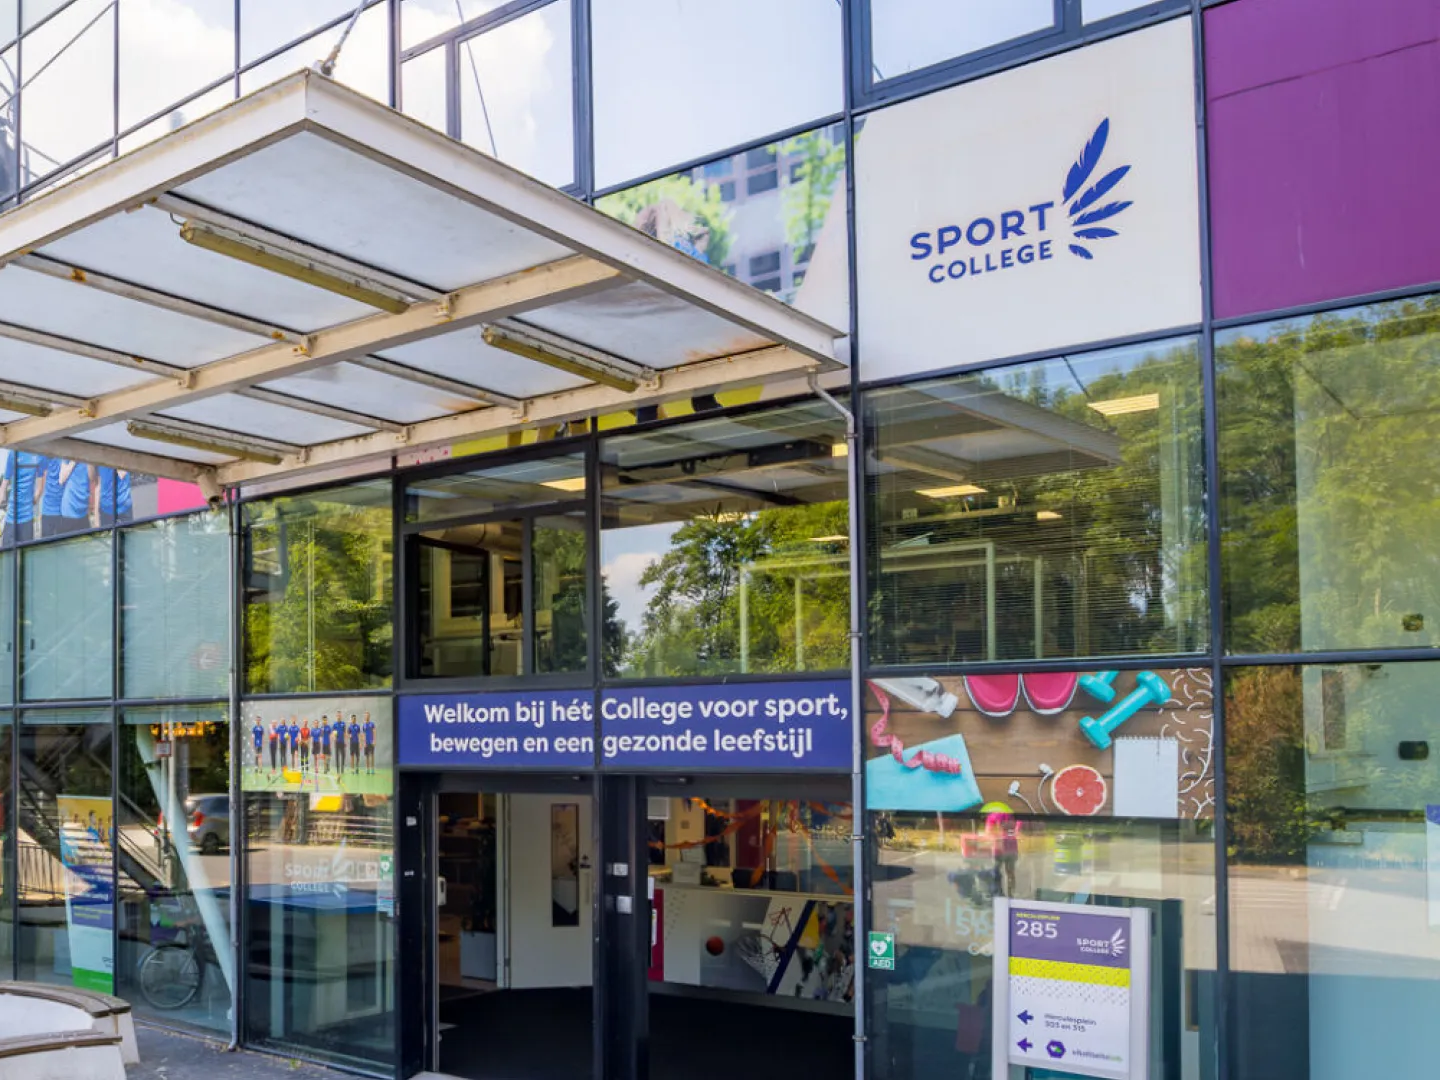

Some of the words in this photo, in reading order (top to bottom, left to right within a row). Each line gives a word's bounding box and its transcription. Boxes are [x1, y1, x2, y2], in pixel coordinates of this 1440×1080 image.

[910, 201, 1054, 260] SPORT
[928, 239, 1053, 283] COLLEGE
[424, 703, 509, 724] Welkom
[515, 700, 545, 728] bij
[551, 698, 593, 722] hét
[601, 696, 693, 725] College
[698, 699, 759, 718] voor
[764, 693, 848, 723] sport,
[430, 733, 518, 758] bewegen
[523, 736, 549, 752] en
[554, 736, 594, 752] een
[602, 729, 707, 757] gezonde
[714, 727, 812, 758] leefstijl
[1016, 920, 1058, 939] 285
[1076, 937, 1110, 948] SPORT
[873, 959, 891, 968] AED
